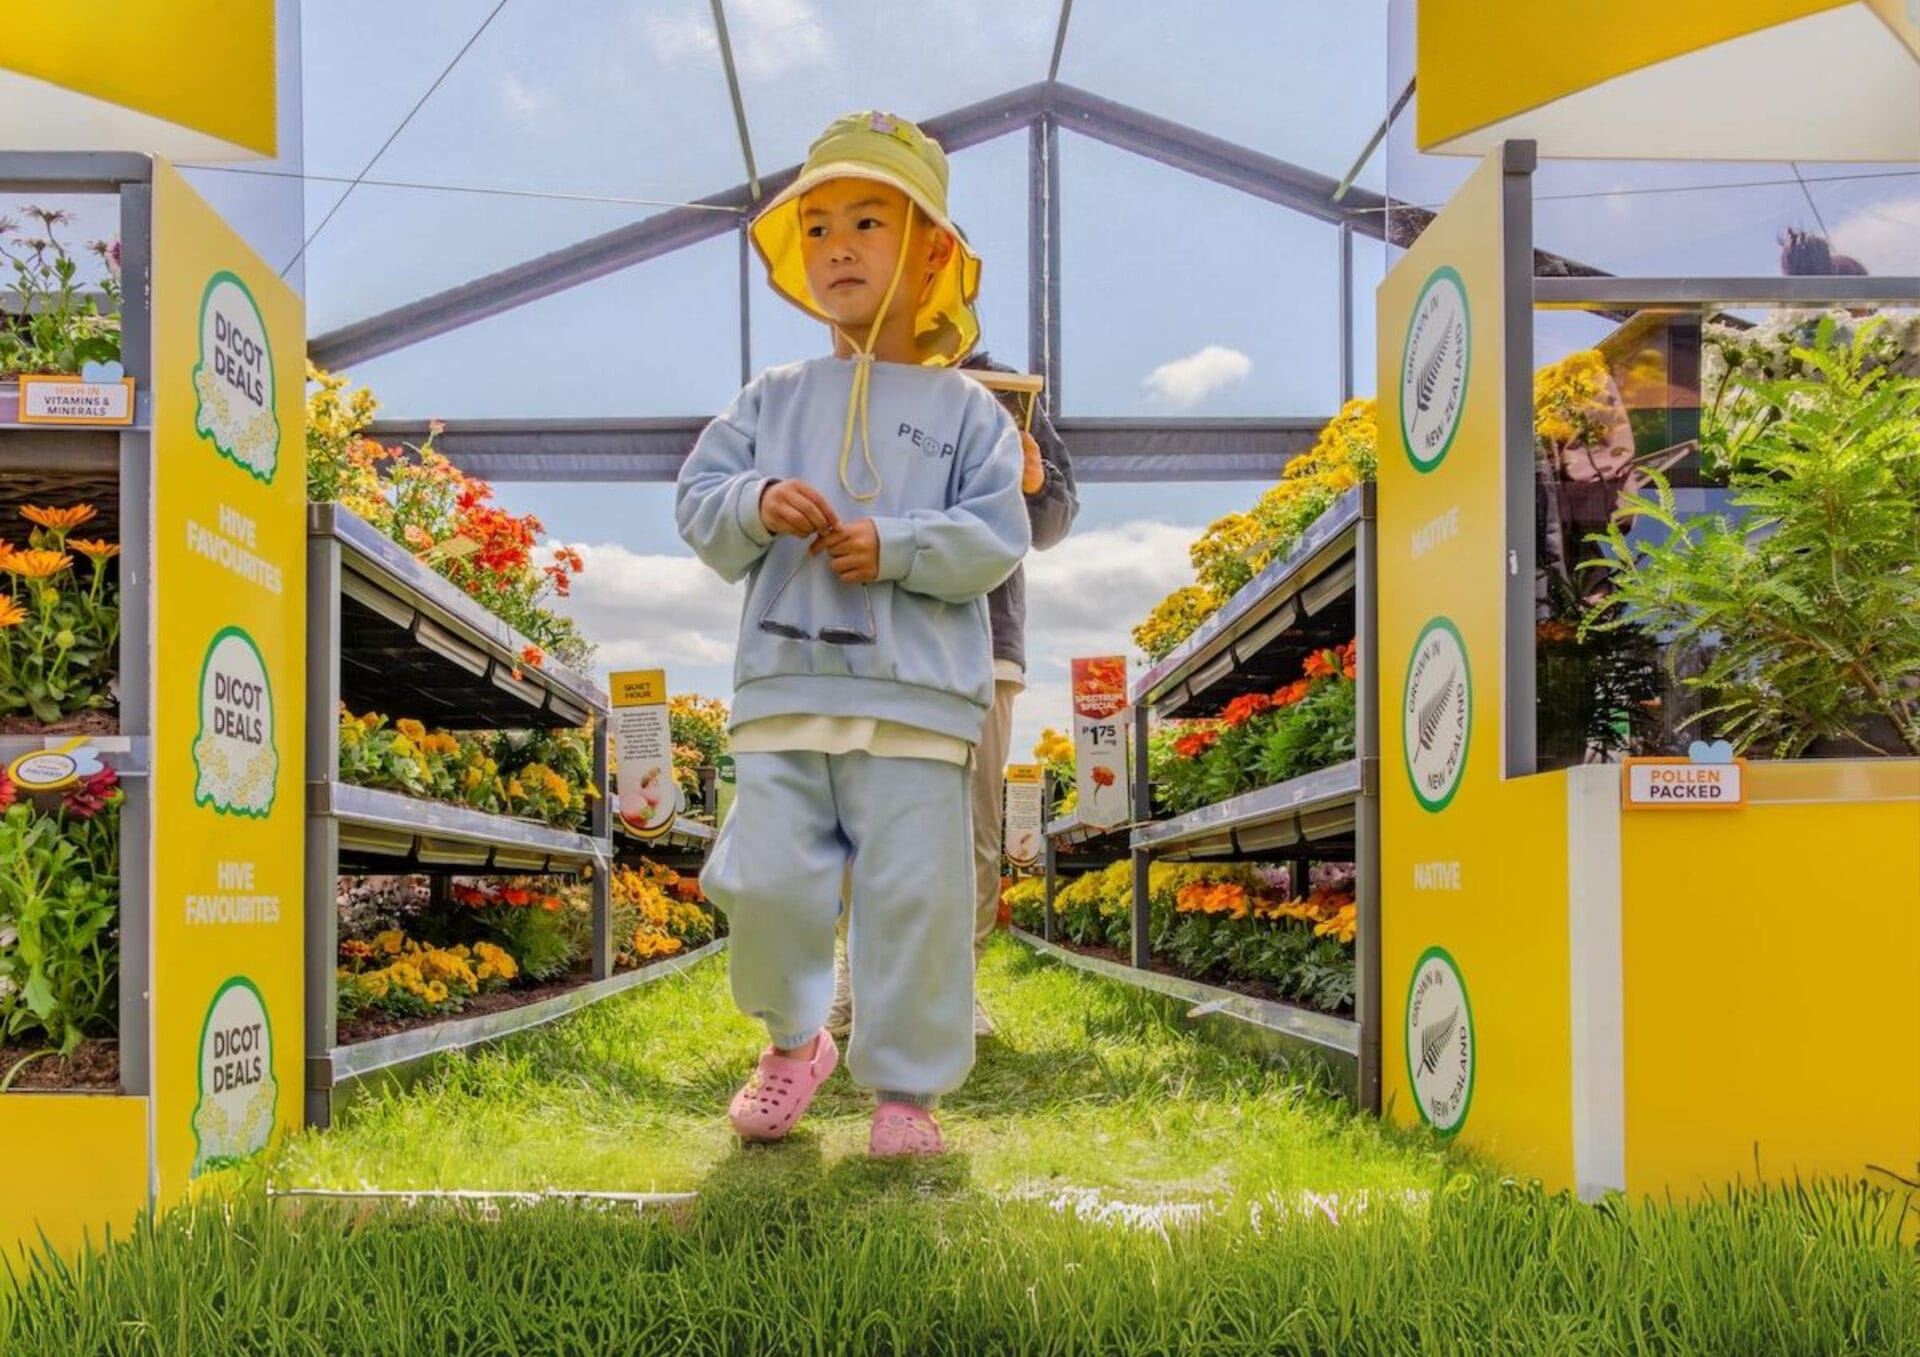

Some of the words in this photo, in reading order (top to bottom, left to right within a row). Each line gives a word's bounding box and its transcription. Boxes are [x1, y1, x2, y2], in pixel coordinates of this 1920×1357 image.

[215, 310, 264, 373] DICOT
[1407, 312, 1428, 384] GROWN
[54, 386, 84, 396] HIGH
[87, 387, 100, 397] IN
[214, 343, 264, 408] DEALS
[1425, 424, 1445, 449] NEW
[1445, 322, 1464, 424] ZEALAND
[44, 396, 100, 406] VITAMINS
[102, 397, 110, 406] &
[47, 406, 107, 416] MINERALS
[218, 502, 257, 551] HIVE
[1410, 505, 1460, 560] NATIVE
[186, 518, 283, 594] FAVOURITES
[215, 671, 263, 712] DICOT
[623, 682, 651, 692] QUIET
[625, 690, 652, 699] HOUR
[1409, 646, 1431, 714] GROWN
[1431, 638, 1442, 658] IN
[214, 706, 262, 744] DEALS
[1081, 702, 1118, 712] SPECIAL
[1427, 768, 1446, 790] NEW
[1446, 682, 1465, 777] ZEALAND
[1649, 785, 1721, 798] PACKED
[1650, 769, 1721, 784] POLLEN
[217, 861, 256, 891] HIVE
[1412, 861, 1461, 890] NATIVE
[185, 895, 281, 926] FAVOURITES
[1411, 973, 1433, 1028] GROWN
[1433, 969, 1443, 988] IN
[214, 1023, 261, 1058] DICOT
[213, 1056, 262, 1094] DEALS
[1431, 1096, 1449, 1119] NEW
[1449, 1025, 1468, 1111] ZEALAND
